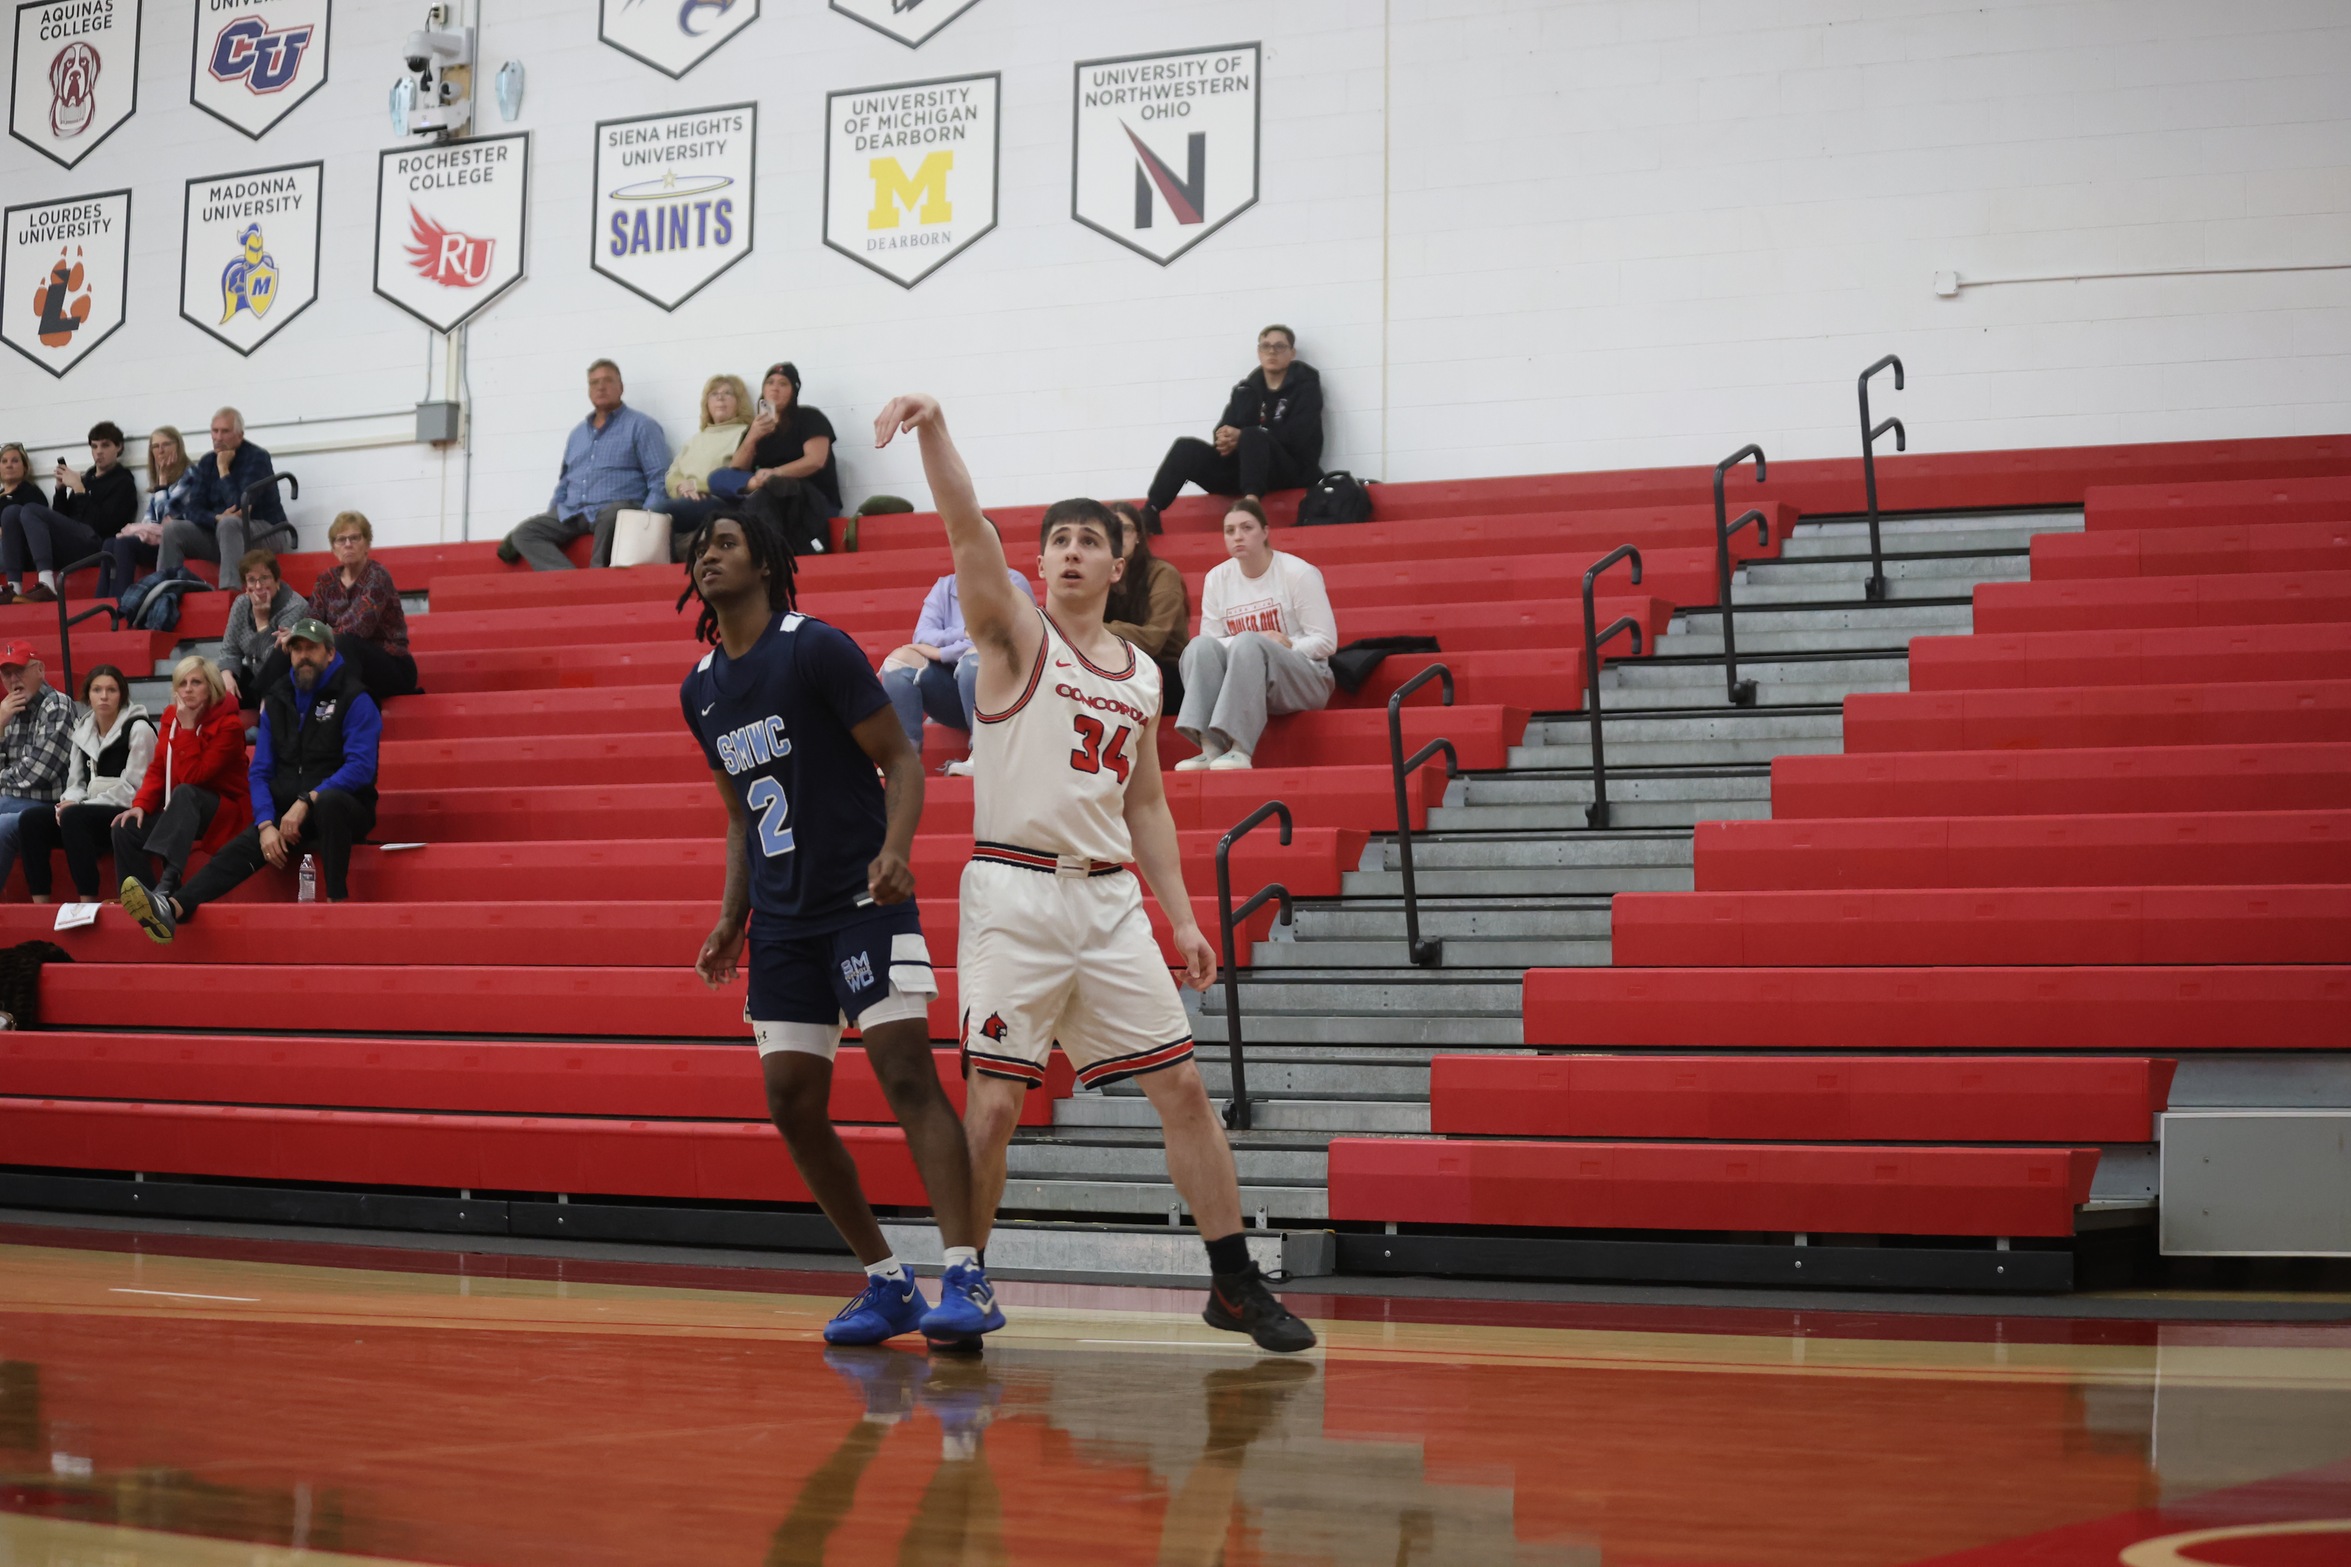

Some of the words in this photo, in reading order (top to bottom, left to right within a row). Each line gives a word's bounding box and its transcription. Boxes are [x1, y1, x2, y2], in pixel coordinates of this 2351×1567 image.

[41, 0, 113, 25] AQUINAS
[40, 14, 113, 41] COLLEGE
[209, 15, 314, 95] CU
[1092, 60, 1208, 87] UNIVERSITY
[1215, 57, 1242, 74] OF
[851, 86, 971, 115] UNIVERSITY
[1085, 75, 1250, 107] NORTHWESTERN
[844, 117, 871, 134] OF
[877, 105, 978, 131] MICHIGAN
[1141, 101, 1191, 121] OHIO
[608, 127, 660, 147] SIENA
[666, 116, 743, 141] HEIGHTS
[855, 125, 966, 151] DEARBORN
[399, 146, 508, 174] ROCHESTER
[621, 138, 728, 167] UNIVERSITY
[209, 176, 296, 202] MADONNA
[409, 166, 494, 191] COLLEGE
[867, 150, 954, 230] M
[30, 203, 102, 228] LOURDES
[202, 194, 303, 222] UNIVERSITY
[19, 218, 112, 245] UNIVERSITY
[610, 198, 734, 257] SAINTS
[866, 230, 952, 251] DEARBORN
[436, 233, 496, 286] RU
[251, 276, 272, 296] M
[716, 715, 792, 775] SMWC
[1070, 714, 1131, 784] 34
[747, 775, 795, 857] 2
